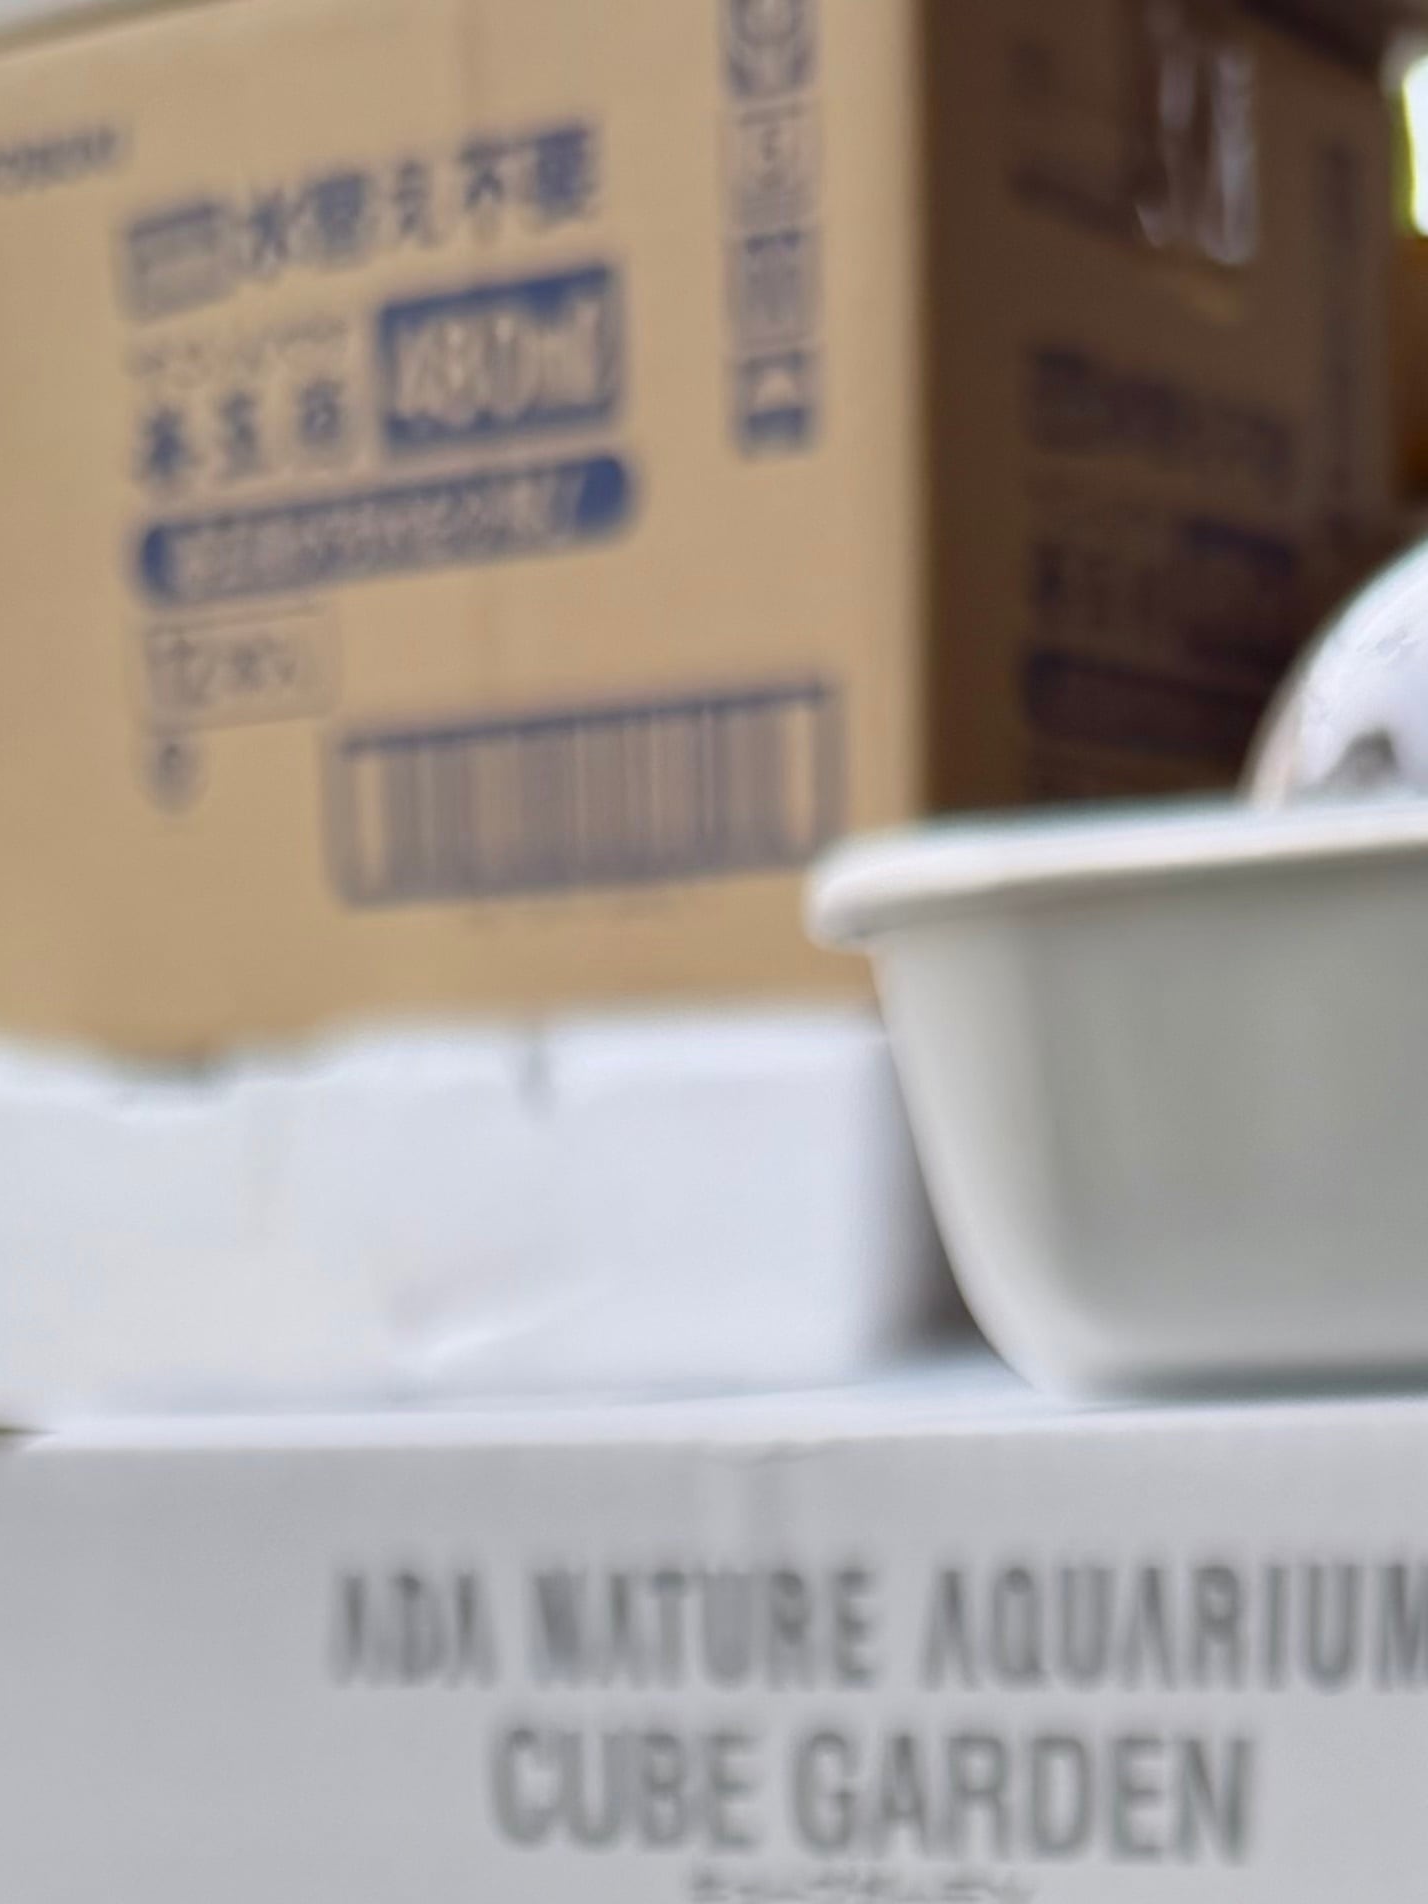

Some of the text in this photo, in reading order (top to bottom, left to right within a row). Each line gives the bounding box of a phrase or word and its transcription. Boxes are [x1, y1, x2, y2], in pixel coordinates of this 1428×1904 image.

[330, 1568, 496, 1690] ADA
[530, 1567, 878, 1691] NATURE
[486, 1726, 1254, 1866] CUBE GARDEN
